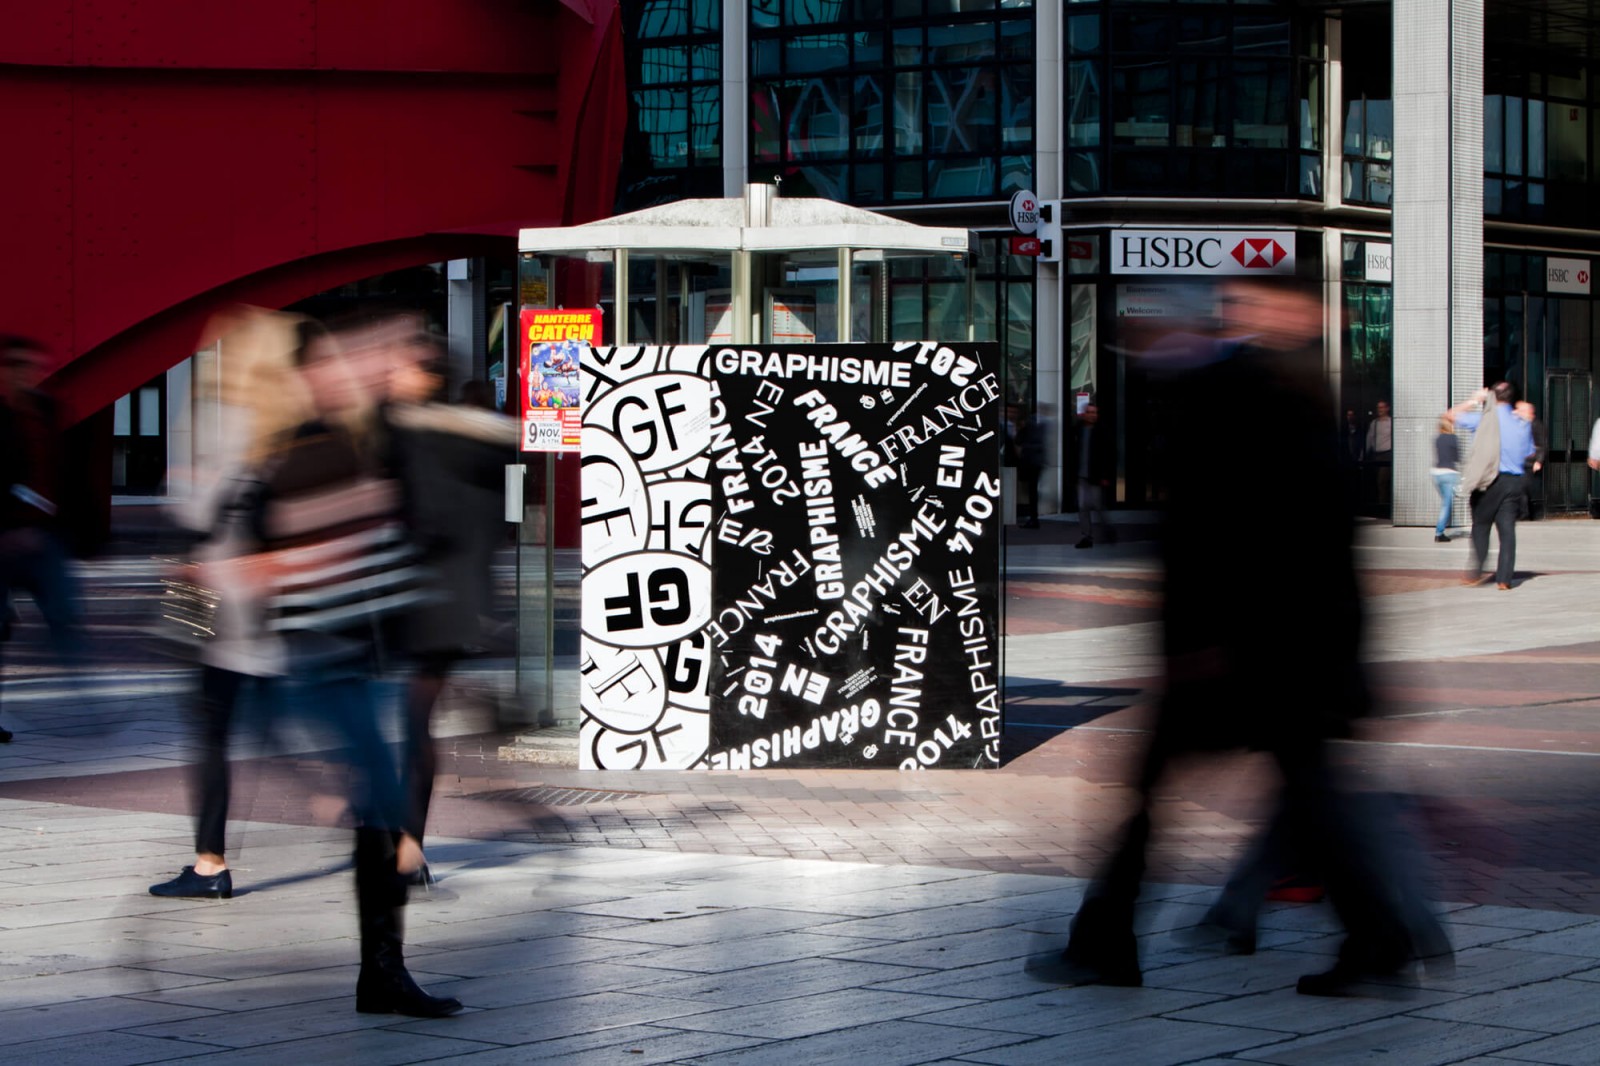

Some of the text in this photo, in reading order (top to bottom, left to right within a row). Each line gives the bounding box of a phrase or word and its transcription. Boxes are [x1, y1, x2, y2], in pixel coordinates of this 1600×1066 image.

[1018, 211, 1039, 223] HSBC
[1119, 236, 1222, 269] HSBC
[1367, 253, 1391, 270] HSBC
[1548, 268, 1569, 283] HSBC
[528, 324, 594, 341] CATCH
[534, 313, 592, 324] NANTERRE
[715, 348, 912, 388] GRAPHISME
[529, 422, 538, 443] 9
[539, 428, 560, 438] NOV.
[612, 382, 687, 462] GF
[745, 380, 784, 429] EN
[877, 372, 1000, 464] FRANCE
[741, 435, 801, 506] 2014
[793, 389, 897, 489] FRANCE
[936, 445, 965, 488] EN
[799, 439, 845, 600] GRAPHISME
[946, 471, 1000, 555] 2014
[604, 567, 691, 632] GF
[706, 548, 811, 648] FRANCE
[815, 503, 947, 655] GRAPHISME
[901, 576, 951, 625] EN
[664, 632, 710, 697] G
[738, 633, 783, 719] 2014
[780, 663, 830, 705] EN
[884, 627, 929, 747] FRANCE
[948, 566, 1000, 763] GRAPHISME
[710, 697, 881, 770] GRAPHISME
